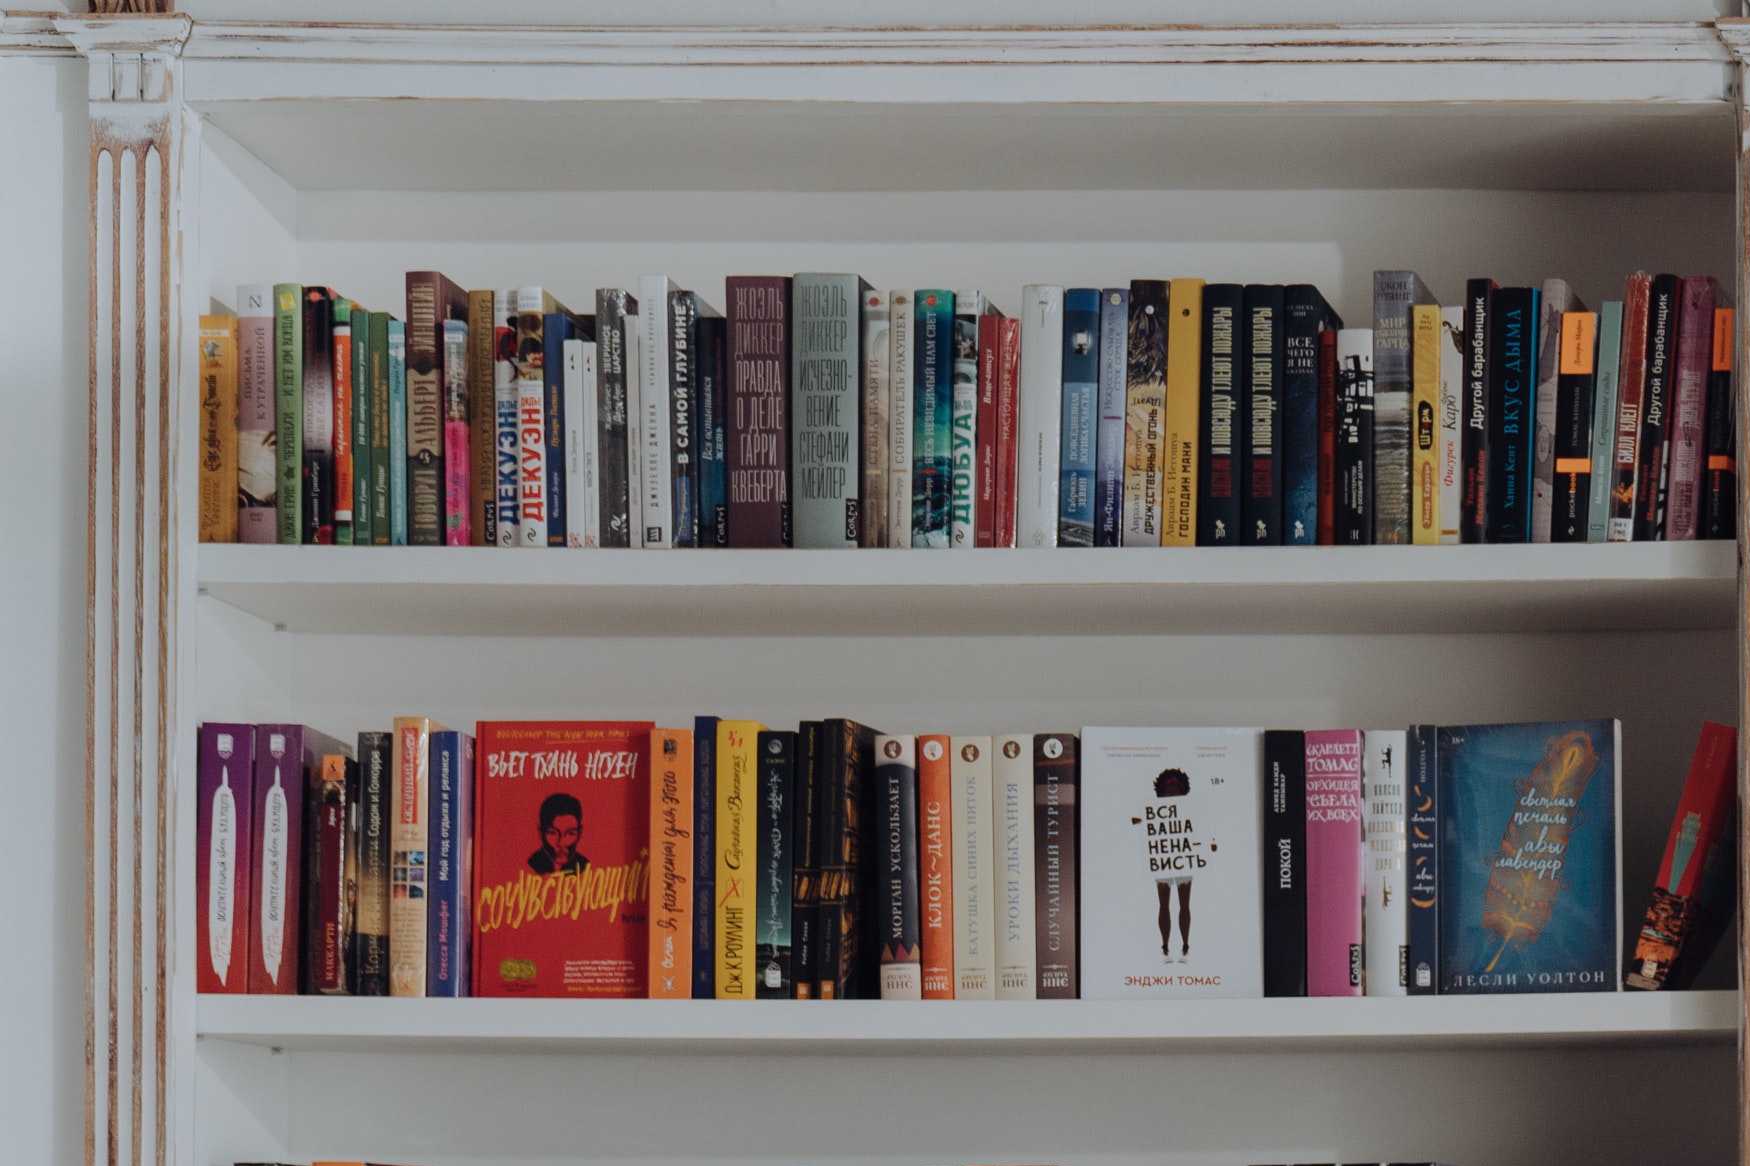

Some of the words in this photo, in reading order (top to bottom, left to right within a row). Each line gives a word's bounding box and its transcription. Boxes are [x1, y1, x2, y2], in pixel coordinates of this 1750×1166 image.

[675, 305, 688, 382] ГЛУБИНЕ
[895, 312, 906, 372] РАКУШЕК
[1212, 307, 1232, 353] ПОЖАРЫ
[1471, 297, 1484, 377] барабанщик
[1504, 309, 1522, 372] ДЫМА
[736, 360, 782, 397] ПРАВДА
[1212, 357, 1231, 391] ТЛЕЮТ
[676, 387, 690, 448] САМОЙ
[737, 397, 744, 429] О
[750, 397, 783, 431] ДЕЛЕ
[894, 378, 905, 464] СОБИРАТЕЛЬ
[1212, 394, 1236, 445] ПОВСЮДУ
[1471, 382, 1484, 429] Другой
[1504, 379, 1521, 434] ВКУС
[498, 412, 519, 525] ДЕКУЭН
[521, 408, 543, 522] ДЕКУЭН
[678, 454, 689, 464] В
[740, 434, 777, 466] ГАРРИ
[952, 412, 972, 525] ДЮБУА
[1181, 441, 1192, 473] МАНИ
[731, 469, 786, 503] КВЕБЕРТА
[1179, 477, 1191, 538] ГОСПОДИН
[488, 750, 528, 778] ВЬЕТ
[532, 750, 579, 779] ТХАНЬ
[585, 750, 637, 779] НГУЕН
[889, 776, 901, 872] УСКОЛЬЗАЕТ
[1006, 783, 1020, 874] ДЫХАНИЯ
[1047, 773, 1059, 838] ТУРИСТ
[1146, 805, 1177, 820] ВСЯ
[1147, 819, 1193, 836] ВАША
[1148, 837, 1202, 854] НЕНА-
[1149, 854, 1207, 872] ВИСТЬ
[1279, 839, 1291, 888] ПОКОЙ
[891, 879, 904, 939] МОРГАН
[1008, 881, 1020, 941] УРОКИ
[1047, 844, 1060, 951] СЛУЧАЙНЫЙ
[1123, 975, 1176, 987] ЭНДЖИ
[1179, 975, 1222, 986] ТОМАС
[1453, 974, 1518, 987] ЛЕСЛИ
[1527, 971, 1605, 985] УОЛТОН
